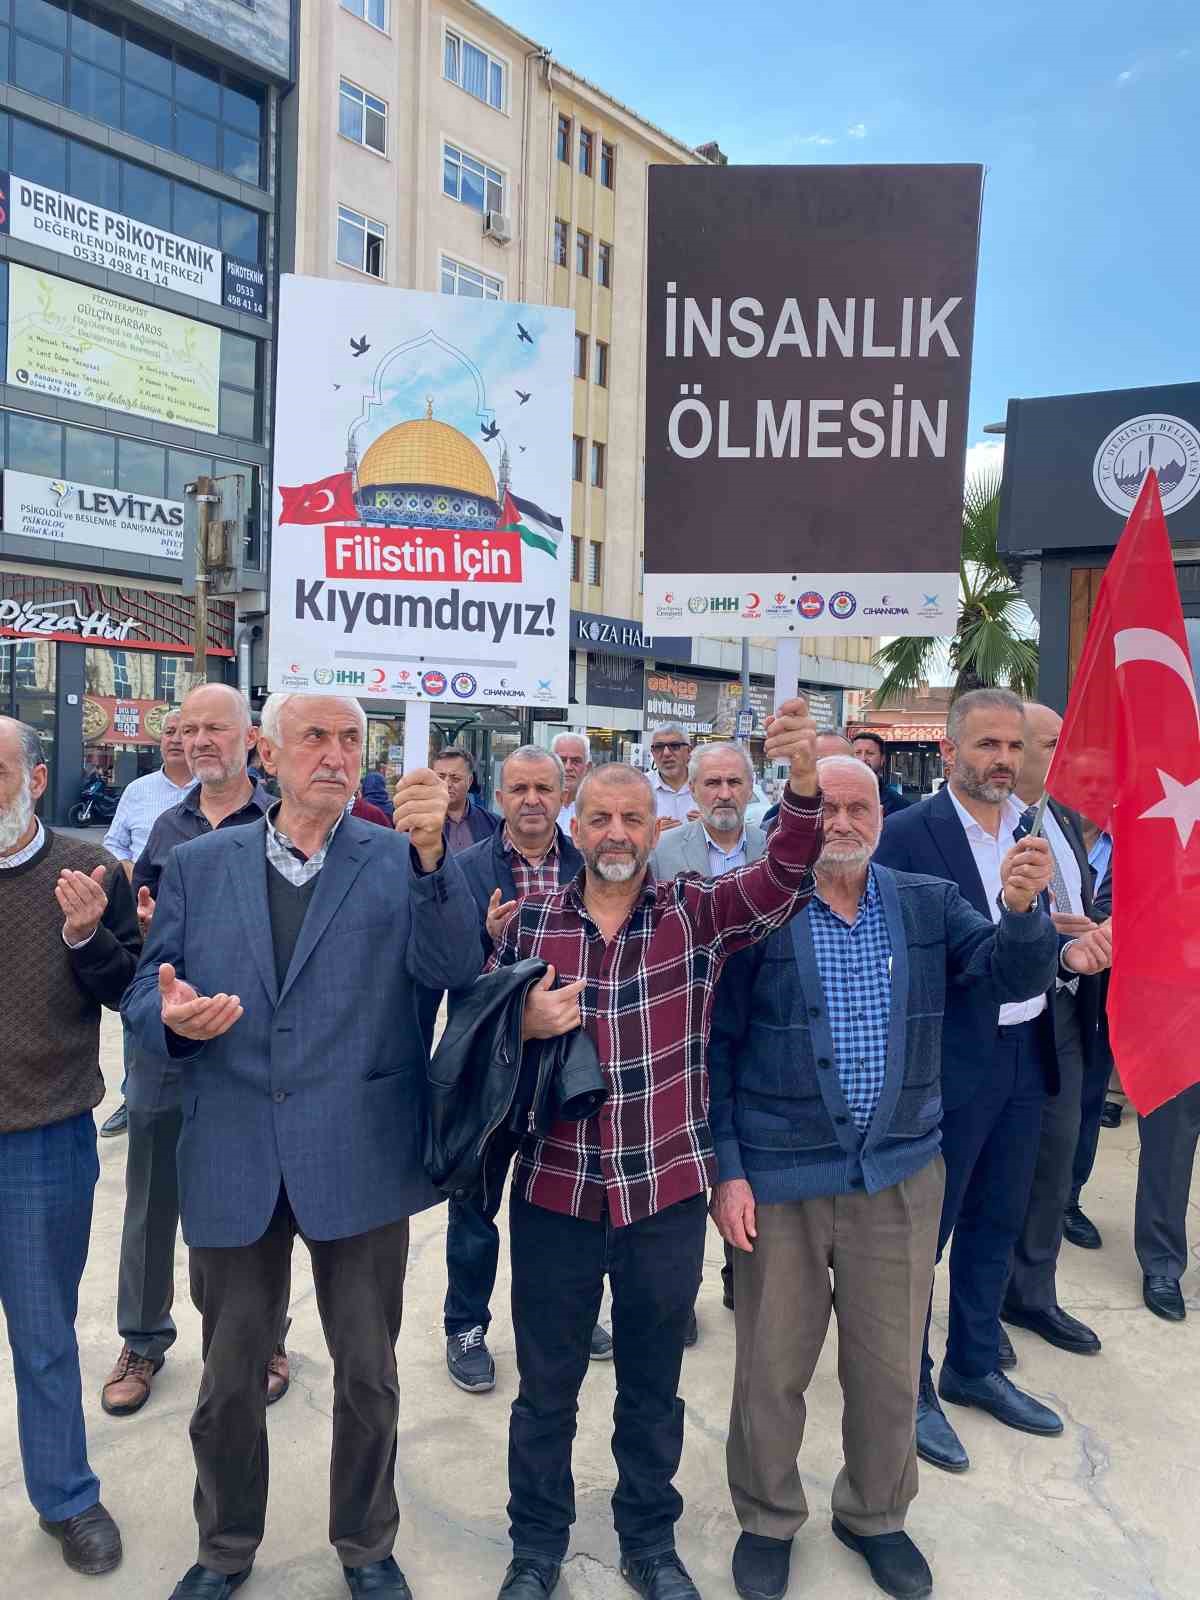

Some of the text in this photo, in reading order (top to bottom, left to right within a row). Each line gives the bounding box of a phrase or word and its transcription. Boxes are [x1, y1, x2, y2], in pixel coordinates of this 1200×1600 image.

[20, 185, 98, 231] DERİNCE
[105, 216, 214, 272] PSİKOTEKNİK
[33, 216, 204, 285] DEĞERLENDİRME MERKEZİ
[73, 246, 168, 286] 0533 498 41 14
[227, 261, 264, 284] PSİKOTEKNİK
[236, 284, 254, 297] 0533
[77, 303, 162, 336] GÜLÇİN BARBAROS
[227, 294, 263, 313] 498 41 14
[666, 282, 962, 358] İNSANLIK
[669, 384, 947, 458] ÖLMESİN
[20, 504, 62, 517] PSİKOLOJİ
[64, 512, 72, 520] ve
[75, 515, 116, 527] BESLENME
[120, 521, 172, 537] DANIŞMANLIK
[79, 490, 183, 526] LEVİTAS
[336, 534, 511, 580] Filistin İçin
[0, 599, 142, 641] Pizza Hut
[296, 579, 556, 643] Kıyamdayız!
[647, 698, 696, 719] BÜYÜK AÇILIŞ
